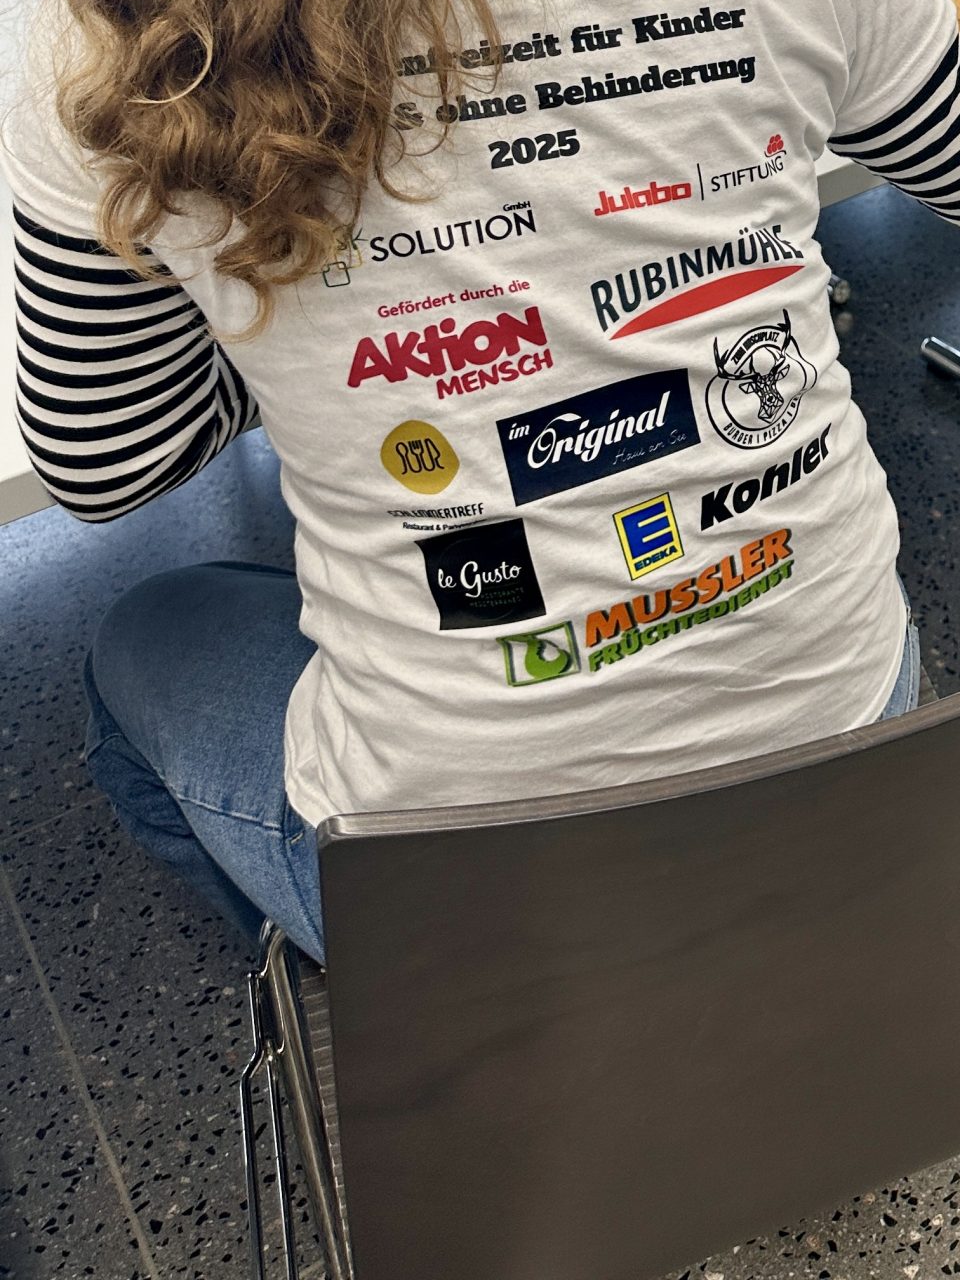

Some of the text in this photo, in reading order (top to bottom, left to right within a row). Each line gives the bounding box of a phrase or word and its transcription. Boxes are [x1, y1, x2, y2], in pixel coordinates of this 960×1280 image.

[570, 24, 623, 54] für
[632, 7, 746, 44] Kinder
[436, 94, 527, 124] ohne
[534, 56, 756, 110] Behinderung
[488, 128, 581, 170] 2025
[502, 200, 531, 212] GmbH
[594, 156, 785, 217] Julabo STIFTUNG
[369, 209, 537, 262] SOLUTION
[377, 279, 531, 318] Gefördert durch die
[590, 224, 804, 333] RUBINMÜHLE
[436, 348, 554, 400] MENSCH
[508, 390, 672, 469] im Original
[723, 419, 788, 445] BURGER PIZZA
[621, 501, 675, 559] E
[438, 561, 522, 598] le Gusto
[634, 545, 678, 572] EDEKA
[585, 528, 794, 648] MUSSLER
[588, 559, 795, 672] FRÜCHTEDIENST
